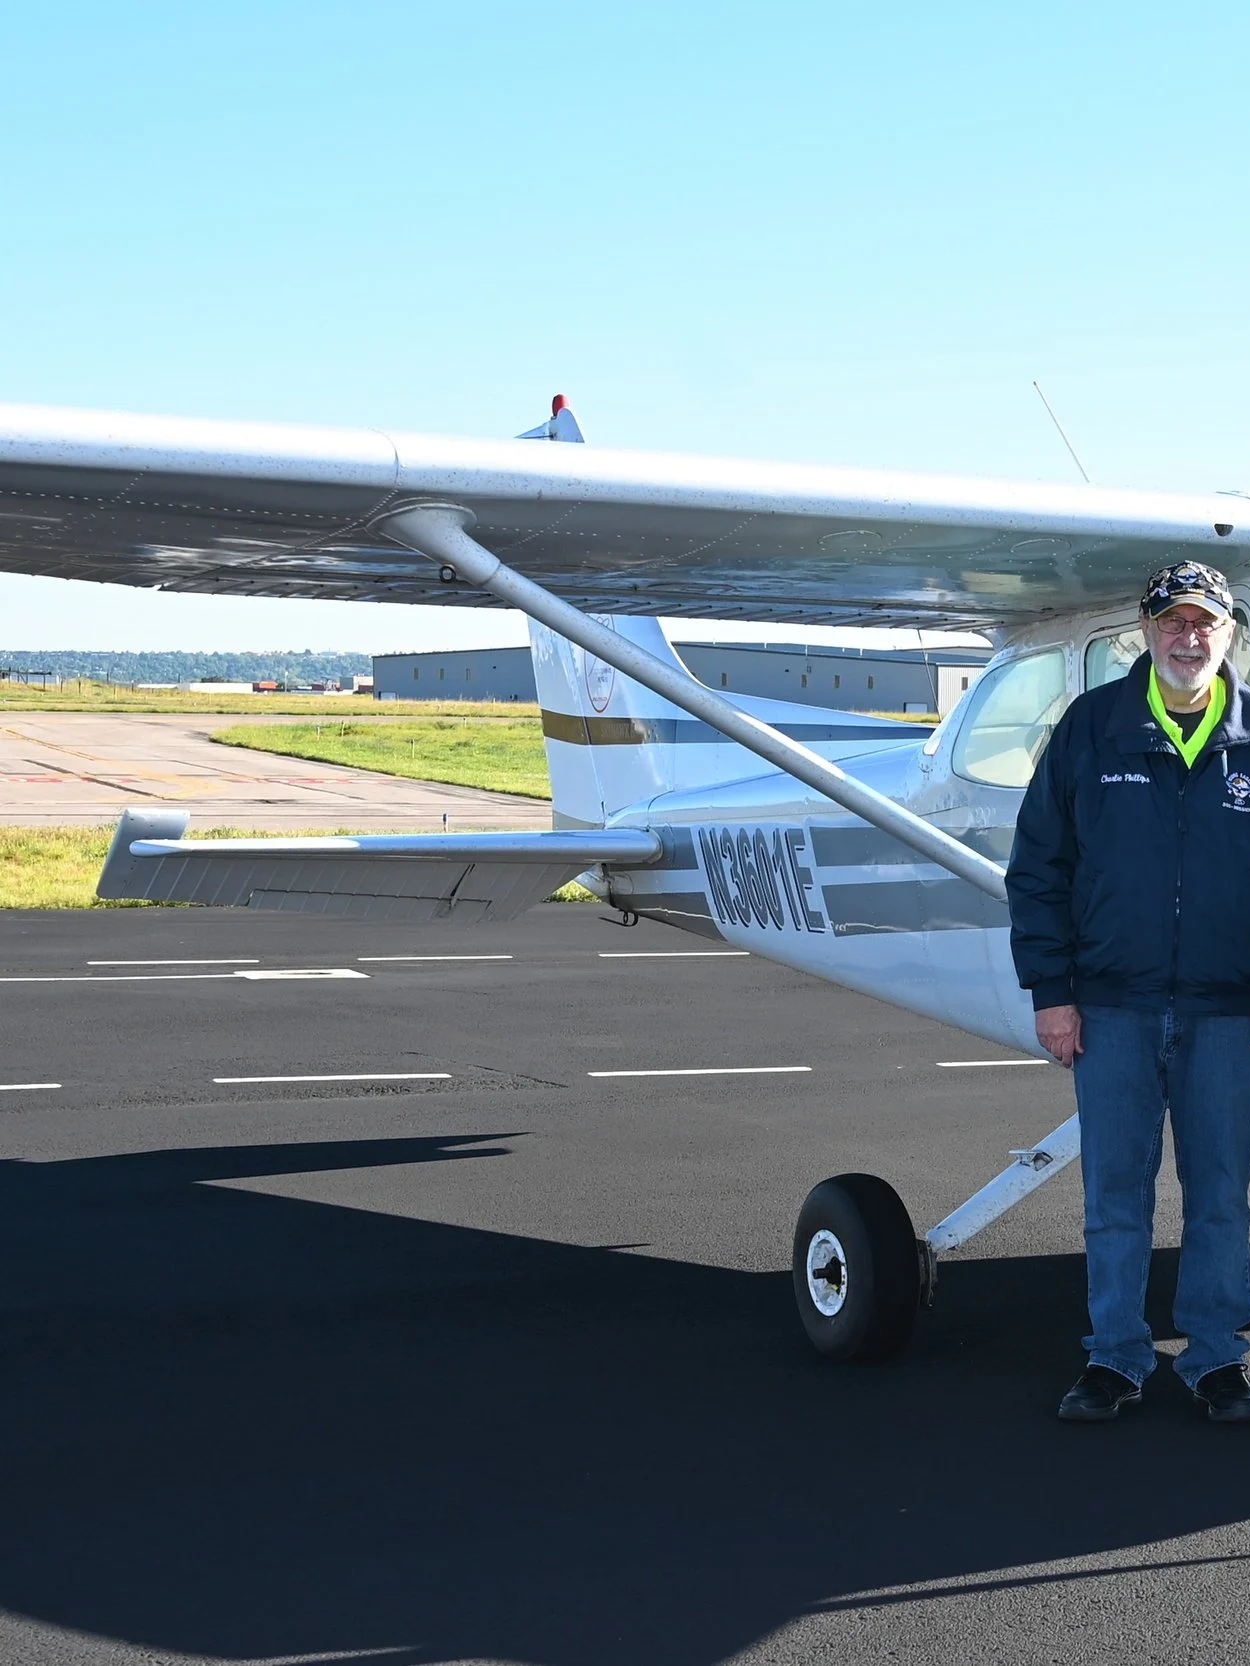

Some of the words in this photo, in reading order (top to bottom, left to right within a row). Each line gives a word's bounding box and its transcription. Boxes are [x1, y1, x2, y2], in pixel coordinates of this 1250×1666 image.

[1101, 774, 1123, 784] Charlie
[1124, 773, 1150, 784] Phillips
[698, 827, 826, 934] N3601E
